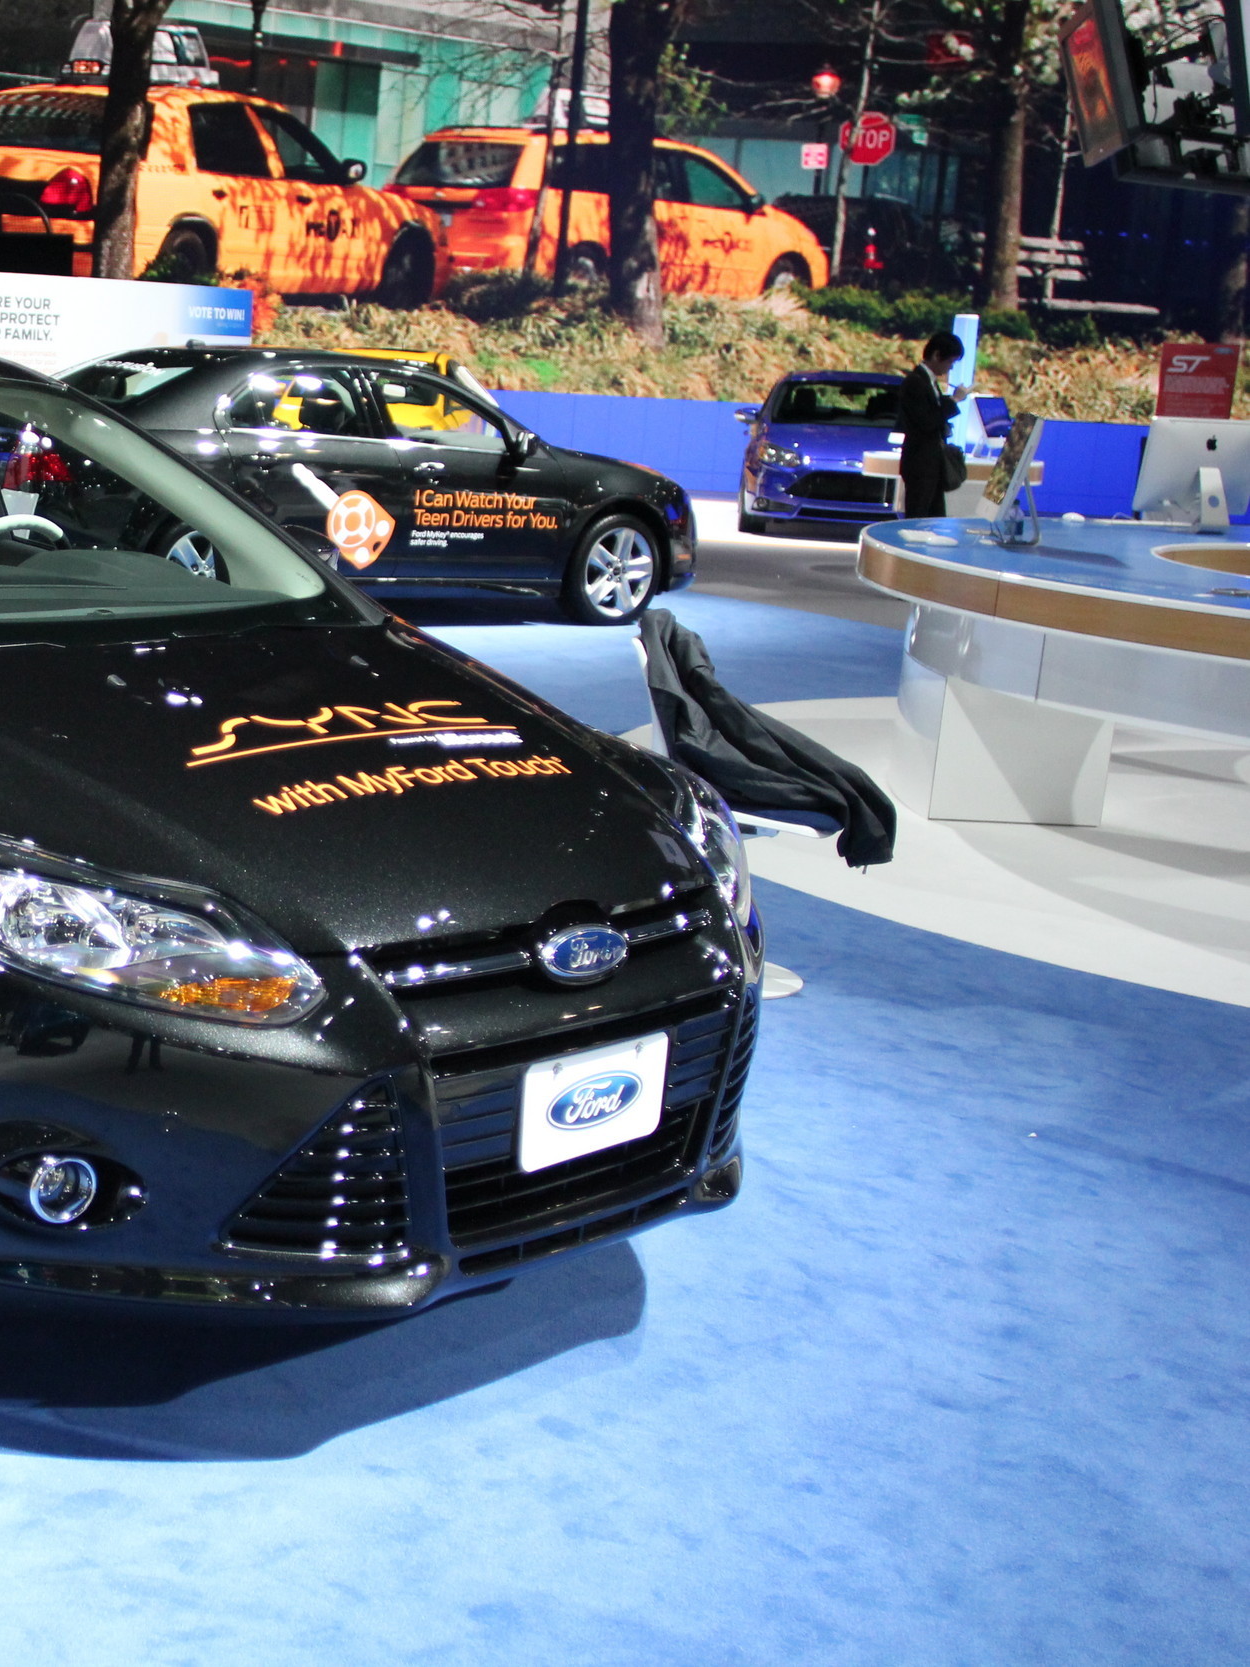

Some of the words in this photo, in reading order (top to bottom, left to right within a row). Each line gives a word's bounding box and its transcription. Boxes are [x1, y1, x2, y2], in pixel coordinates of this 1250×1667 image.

[15, 296, 51, 310] YOUR
[0, 312, 60, 326] PROTECT
[188, 305, 212, 318] VOTE
[214, 307, 226, 320] TO
[226, 308, 245, 321] WIN!
[4, 328, 53, 341] FAMILY.
[1166, 354, 1211, 373] ST
[414, 489, 421, 506] I
[422, 489, 453, 507] Can
[455, 491, 503, 508] Watch
[504, 492, 538, 510] Your
[414, 509, 449, 526] Teen
[452, 510, 503, 528] Drivers
[507, 511, 528, 528] for
[530, 512, 558, 529] You.
[410, 538, 426, 546] safer
[426, 539, 448, 547] driving.
[411, 529, 427, 538] Ford
[450, 532, 484, 541] encourages
[191, 700, 489, 756] SYNC
[253, 780, 349, 816] with
[336, 759, 478, 795] MyFord
[568, 933, 622, 968] Ford
[565, 1081, 626, 1123] Ford
